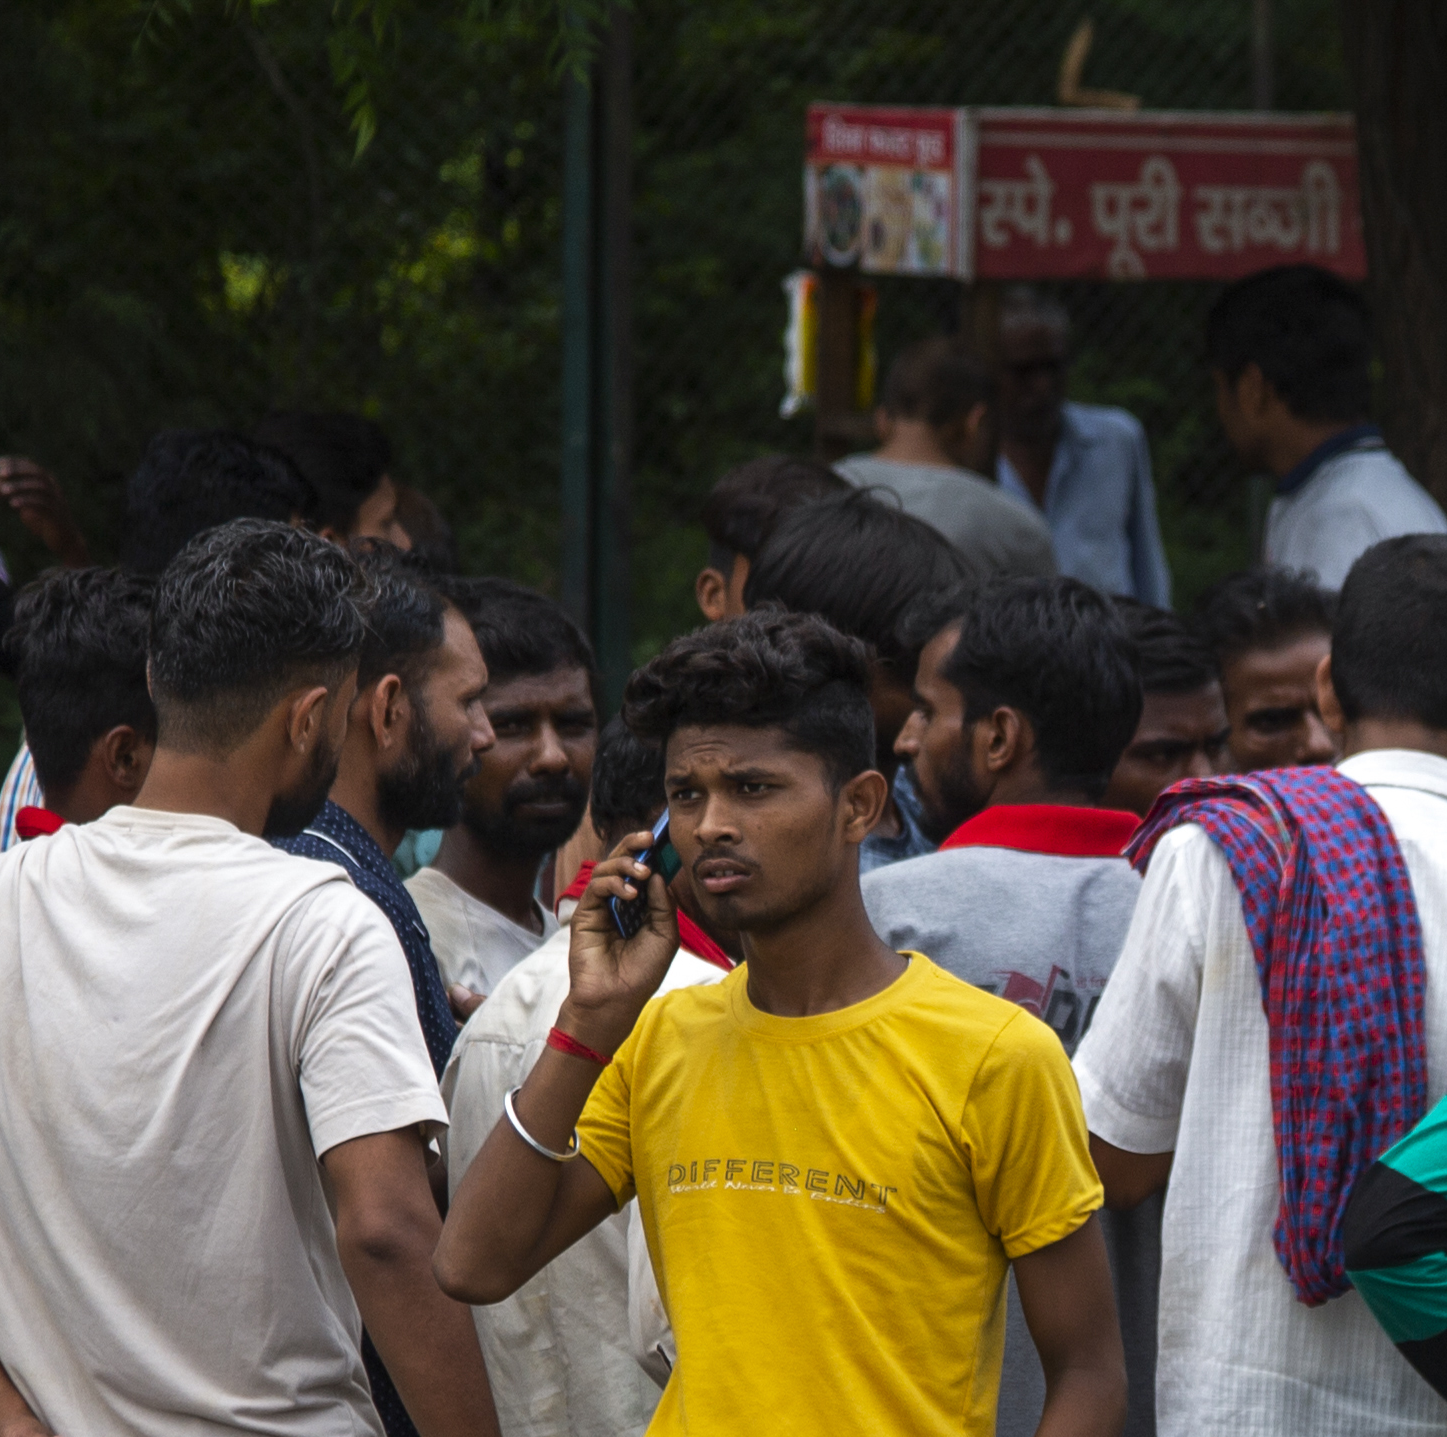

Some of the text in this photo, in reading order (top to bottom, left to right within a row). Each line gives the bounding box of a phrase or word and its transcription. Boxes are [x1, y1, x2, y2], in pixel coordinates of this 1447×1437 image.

[1089, 155, 1182, 280] पूरी
[1193, 160, 1340, 255] सब्जी
[667, 1159, 897, 1206] DIFFERENT
